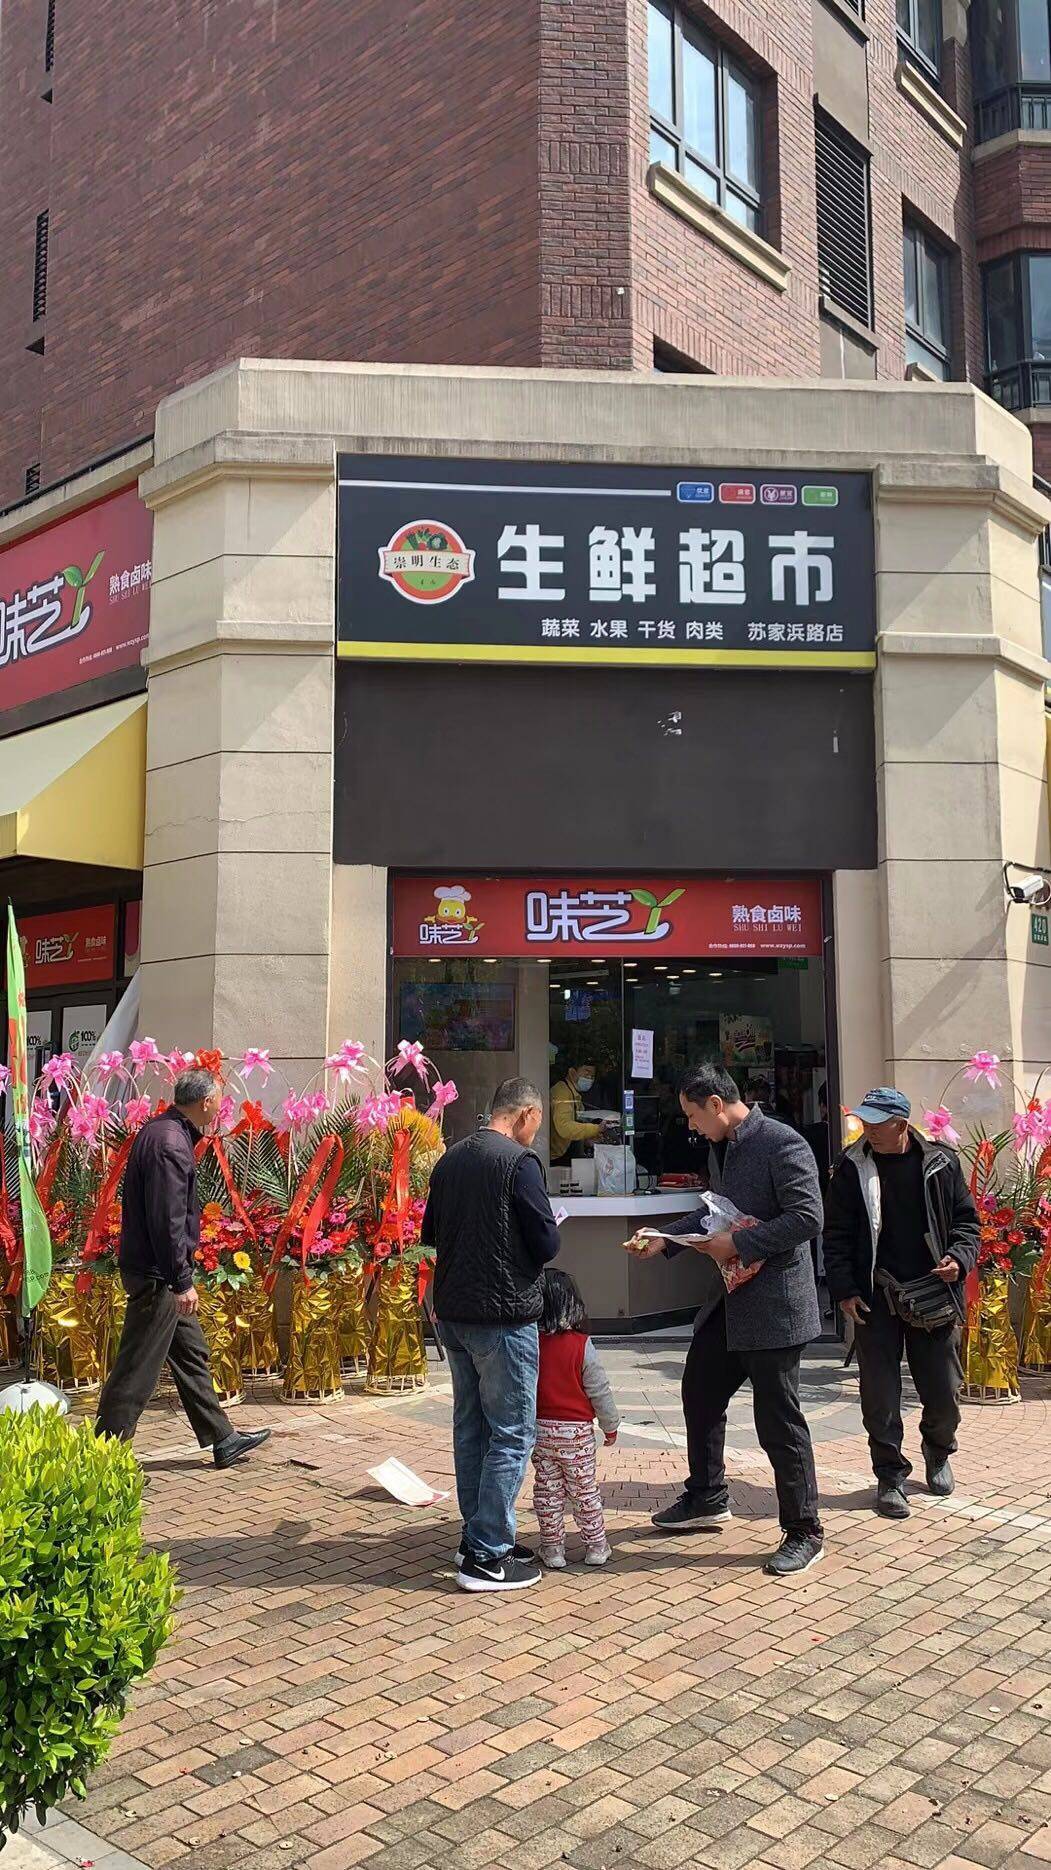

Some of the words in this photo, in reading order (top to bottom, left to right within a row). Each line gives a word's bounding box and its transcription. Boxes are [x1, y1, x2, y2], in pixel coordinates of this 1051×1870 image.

[393, 554, 460, 571] 崇明生态
[497, 523, 835, 606] 生鲜超市
[541, 618, 580, 639] 蔬菜
[590, 619, 629, 640] 水果
[638, 620, 676, 640] 干货
[685, 621, 724, 641] 肉类
[747, 622, 844, 642] 苏家浜路店
[731, 905, 802, 923] 熟食卤味
[81, 1030, 96, 1042] 100%
